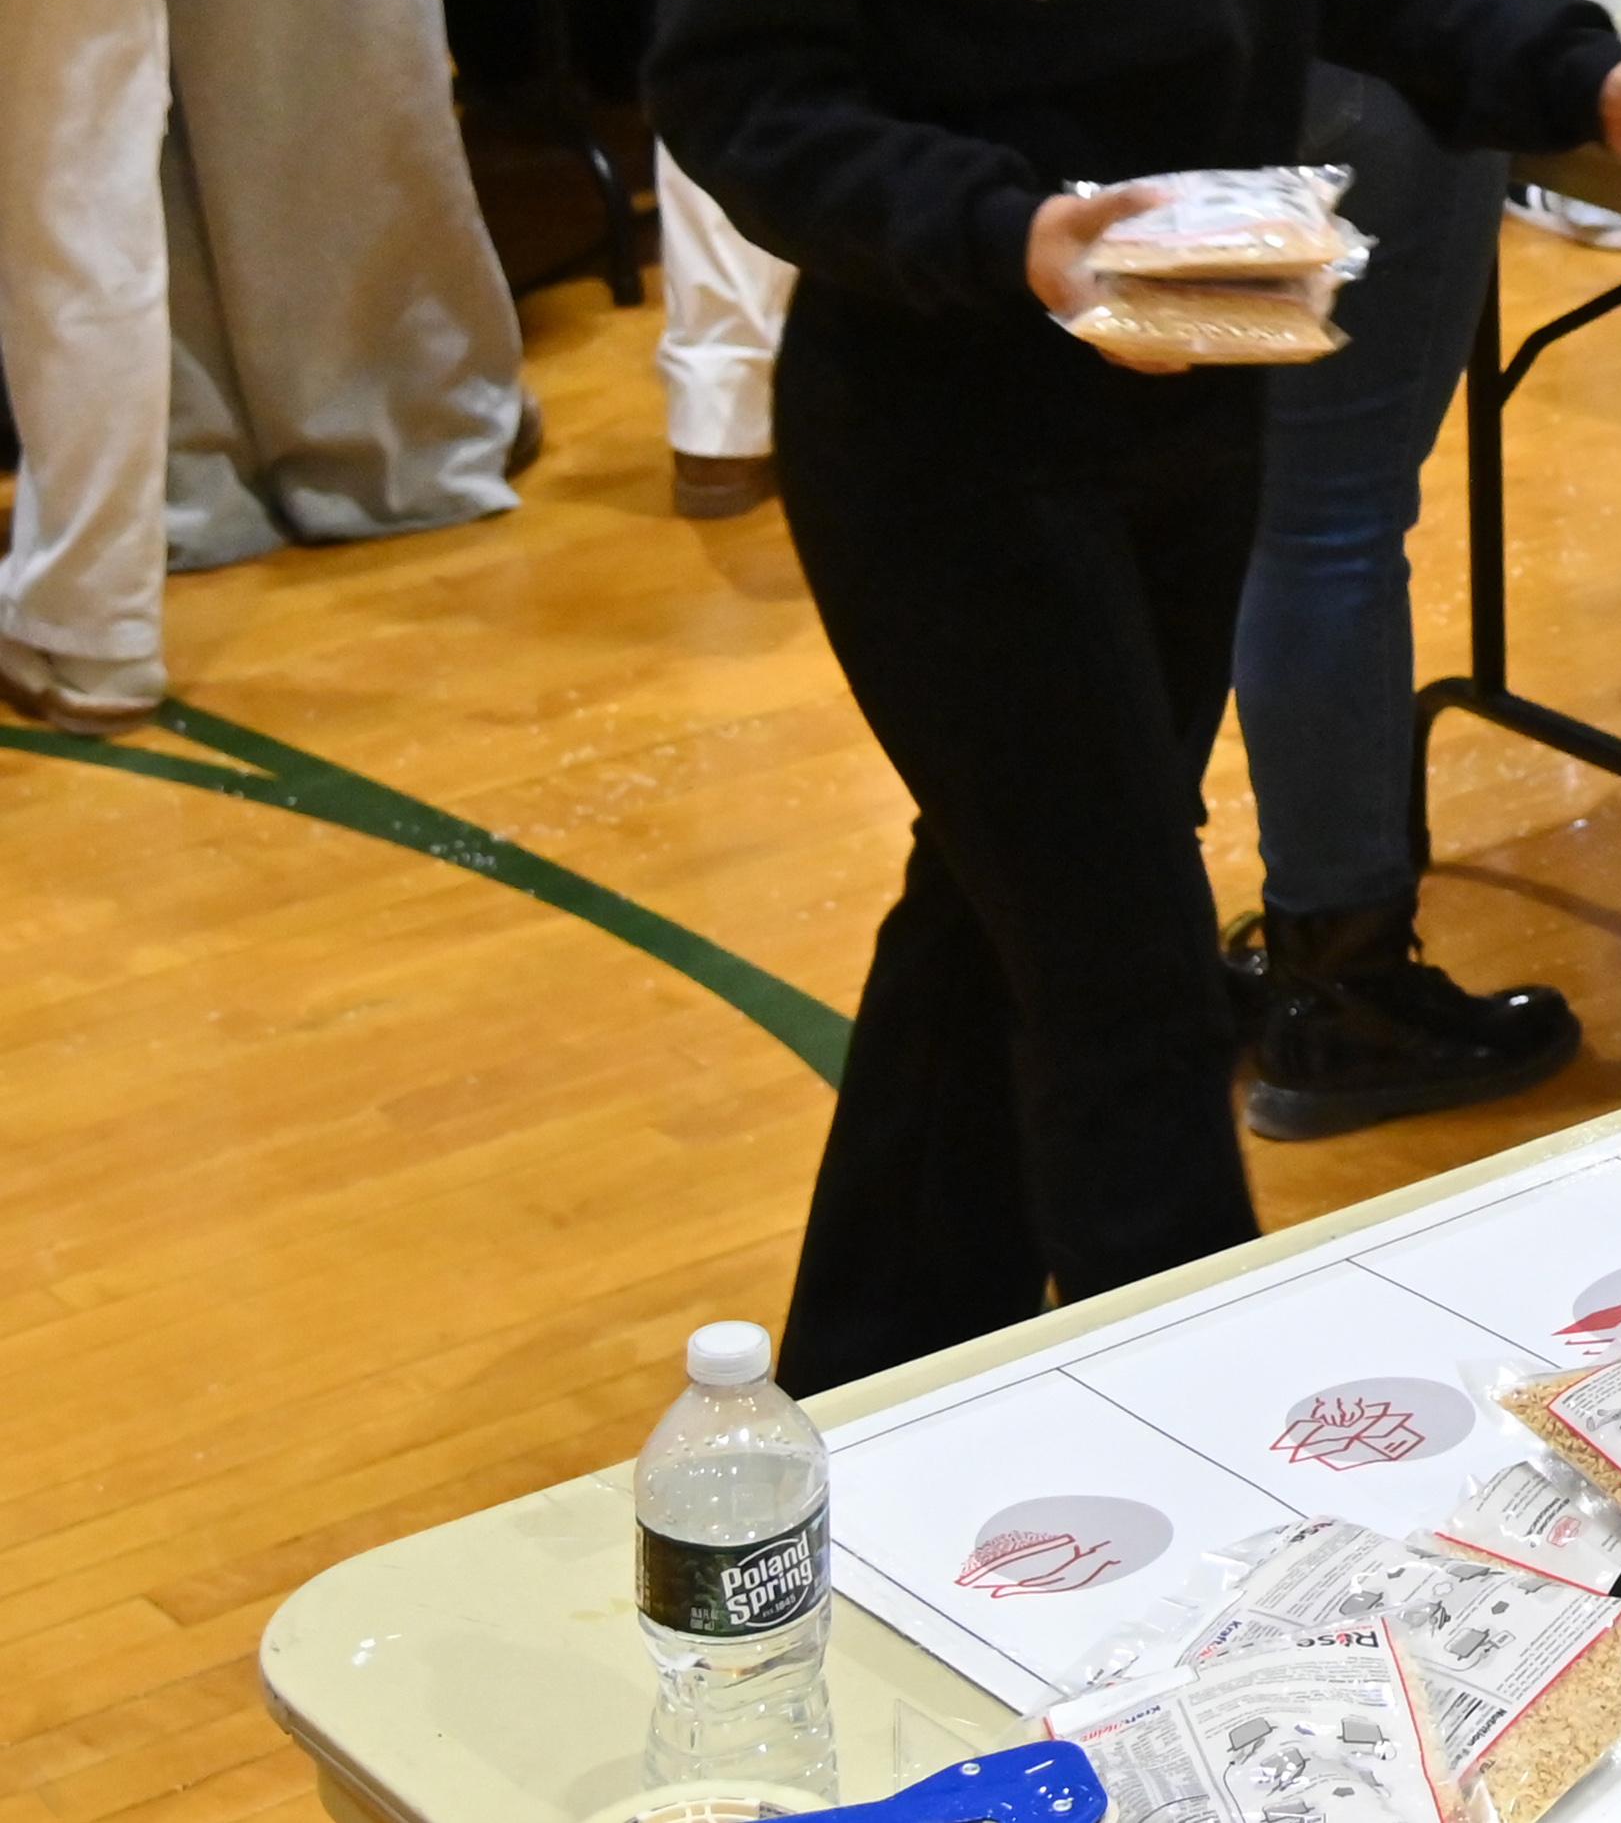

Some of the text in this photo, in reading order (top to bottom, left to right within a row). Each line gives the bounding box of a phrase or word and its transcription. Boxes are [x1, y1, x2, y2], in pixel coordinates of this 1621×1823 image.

[720, 1529, 811, 1600] Poland
[725, 1557, 814, 1626] Spring
[1296, 1630, 1380, 1649] Rise
[1467, 1707, 1508, 1747] Nutrition
